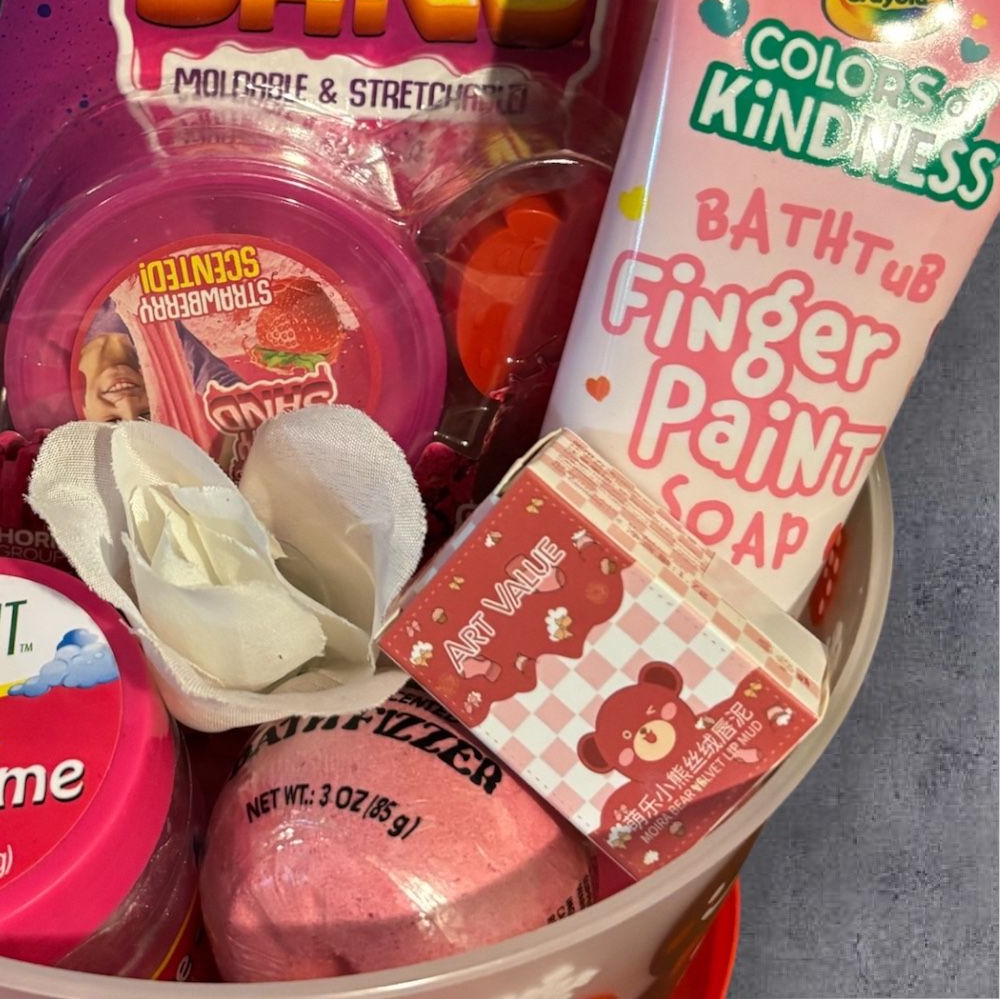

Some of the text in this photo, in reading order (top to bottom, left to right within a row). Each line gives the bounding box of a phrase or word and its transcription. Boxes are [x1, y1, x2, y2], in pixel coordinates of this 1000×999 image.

[318, 77, 338, 105] &
[749, 26, 939, 116] COLORS
[139, 245, 262, 295] SCENTED!
[139, 279, 274, 325] STRAWBERRY
[661, 473, 810, 571] SOAP
[443, 535, 567, 674] ART VALUE
[246, 787, 282, 823] NET
[318, 783, 333, 807] 3
[335, 785, 370, 813] OZ
[362, 794, 399, 821] (85
[386, 806, 422, 841] g)
[640, 811, 674, 845] MOIRA
[669, 787, 702, 819] BEAR
[737, 718, 764, 750] MUD
